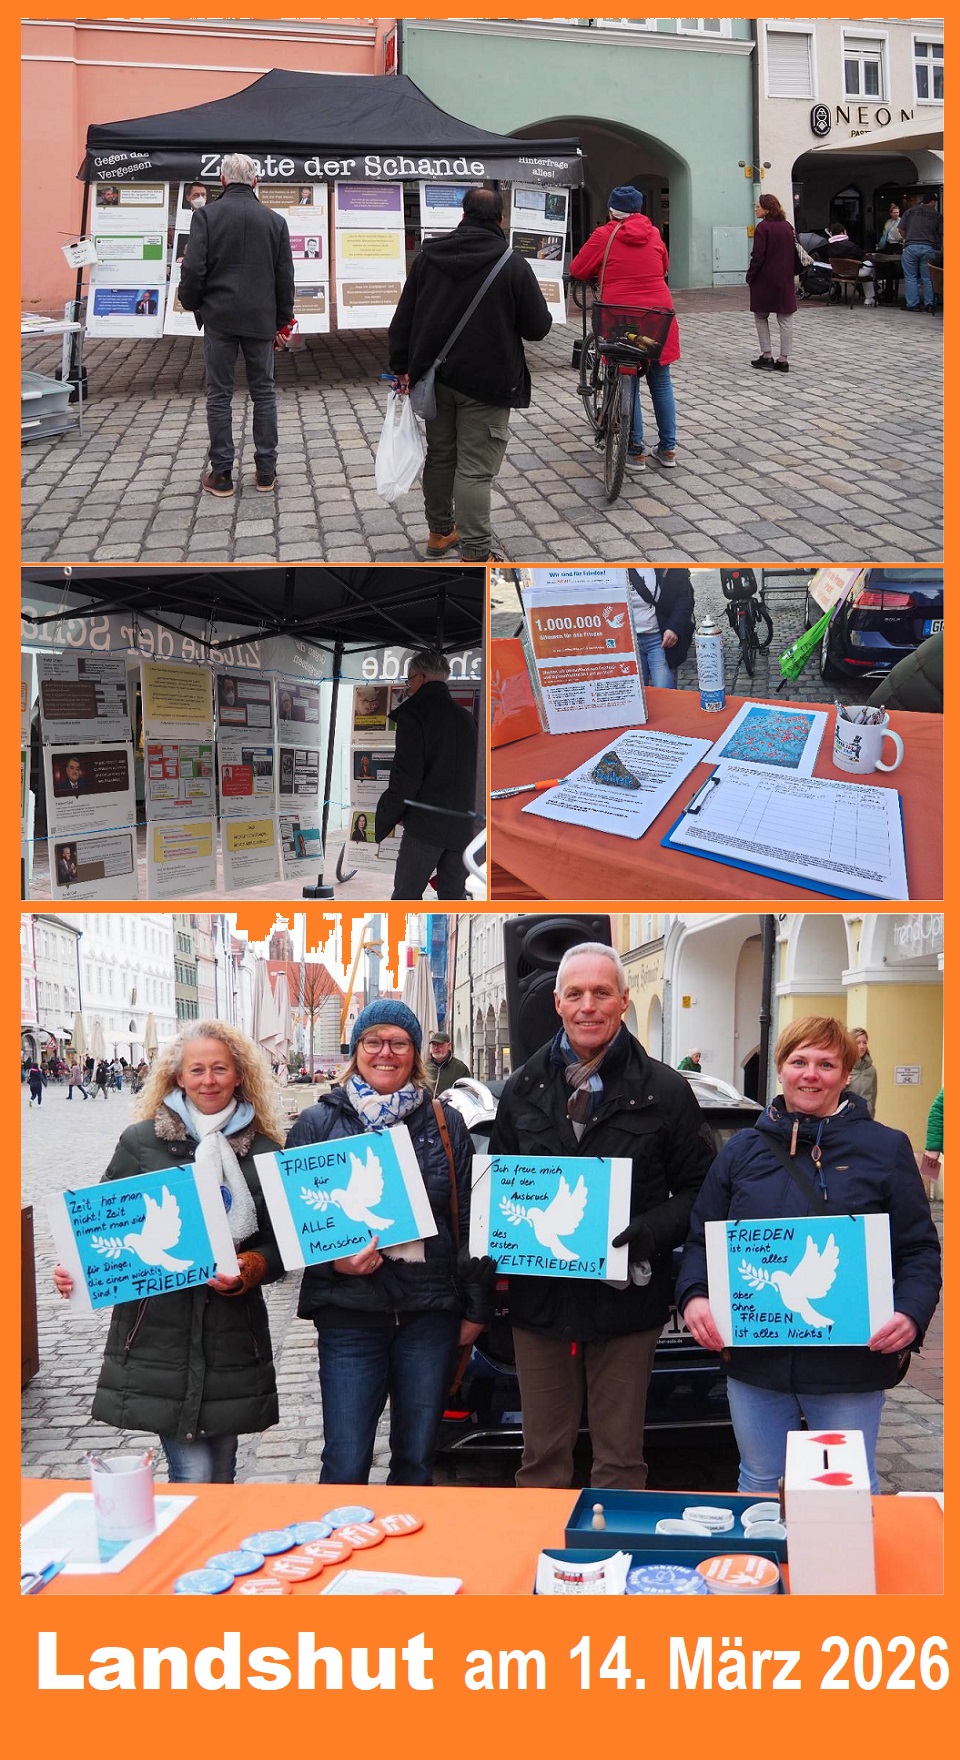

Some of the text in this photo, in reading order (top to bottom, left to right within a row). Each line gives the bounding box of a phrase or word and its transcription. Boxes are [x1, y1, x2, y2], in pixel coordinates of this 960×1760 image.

[836, 105, 914, 126] NEON
[94, 153, 128, 167] Gegen
[200, 153, 486, 177] Zate der Schande
[518, 156, 569, 169] Hinterfrage
[97, 161, 152, 180] Vergessen
[532, 168, 555, 178] alles!
[535, 615, 602, 632] 1.000.000
[584, 630, 603, 638] Frieden
[595, 767, 633, 787] Freiheit
[281, 1152, 347, 1176] FRIEDEN
[493, 1164, 563, 1175] Ich freue mich
[314, 1177, 330, 1188] für
[501, 1177, 535, 1186] auf den
[70, 1192, 143, 1214] Zeit hat man
[510, 1192, 549, 1201] Ausbruch
[74, 1207, 126, 1226] nicht! Zeit
[76, 1214, 146, 1237] nimmt man sich
[302, 1217, 336, 1234] ALLE
[492, 1229, 507, 1239] des
[727, 1228, 795, 1242] FRIEDEN
[490, 1241, 518, 1250] ersten
[730, 1243, 771, 1253] ist nicht
[761, 1254, 788, 1264] alles
[87, 1260, 132, 1277] für Dinge,
[88, 1268, 162, 1287] die einem wichtig
[132, 1263, 219, 1296] FRIEDEN!
[92, 1285, 119, 1300] sind!
[733, 1291, 754, 1300] aber
[731, 1303, 757, 1313] ohne
[740, 1312, 793, 1324] FRIEDEN
[735, 1326, 749, 1338] ist
[754, 1328, 779, 1339] alles
